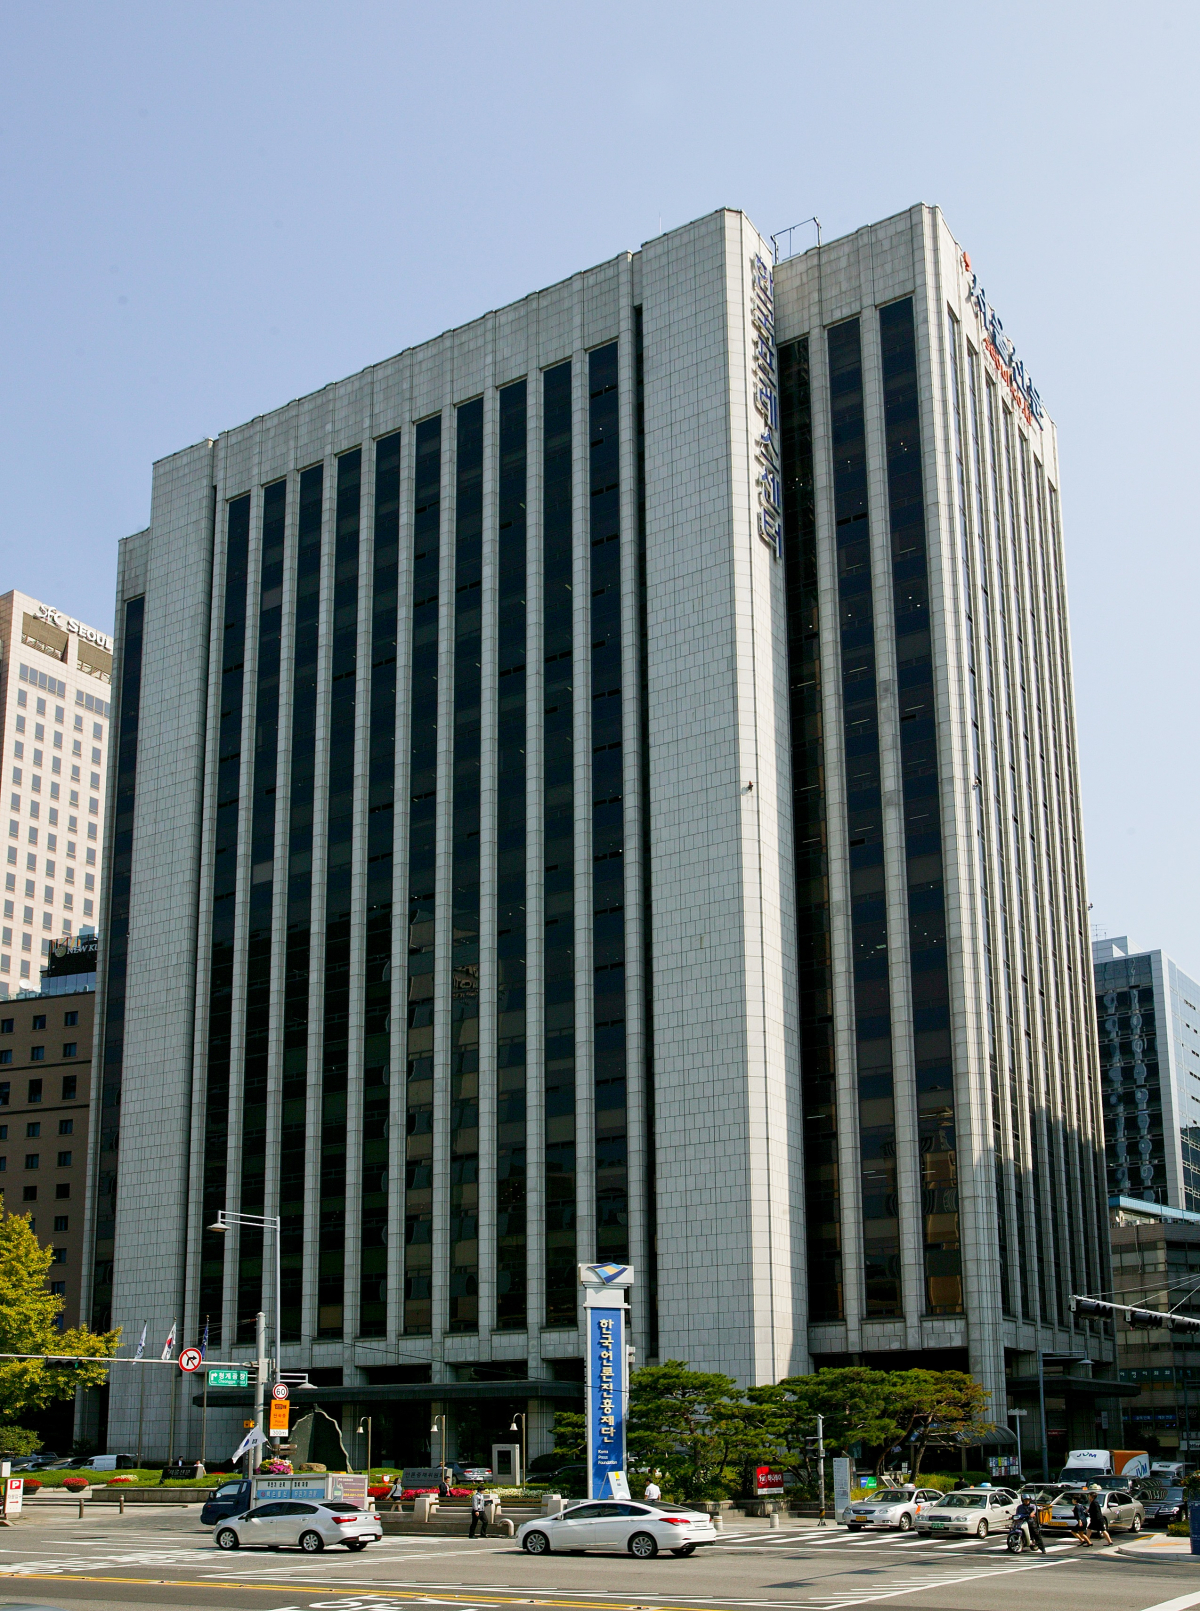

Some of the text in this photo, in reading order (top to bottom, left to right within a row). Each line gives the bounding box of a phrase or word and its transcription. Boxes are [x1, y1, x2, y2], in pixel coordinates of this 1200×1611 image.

[67, 617, 113, 651] SEOUL
[66, 944, 88, 955] NEW
[218, 1372, 246, 1380] 청계광장
[600, 1319, 615, 1443] 한국언론진흥재단
[276, 1388, 286, 1396] 60
[12, 1481, 20, 1489] P
